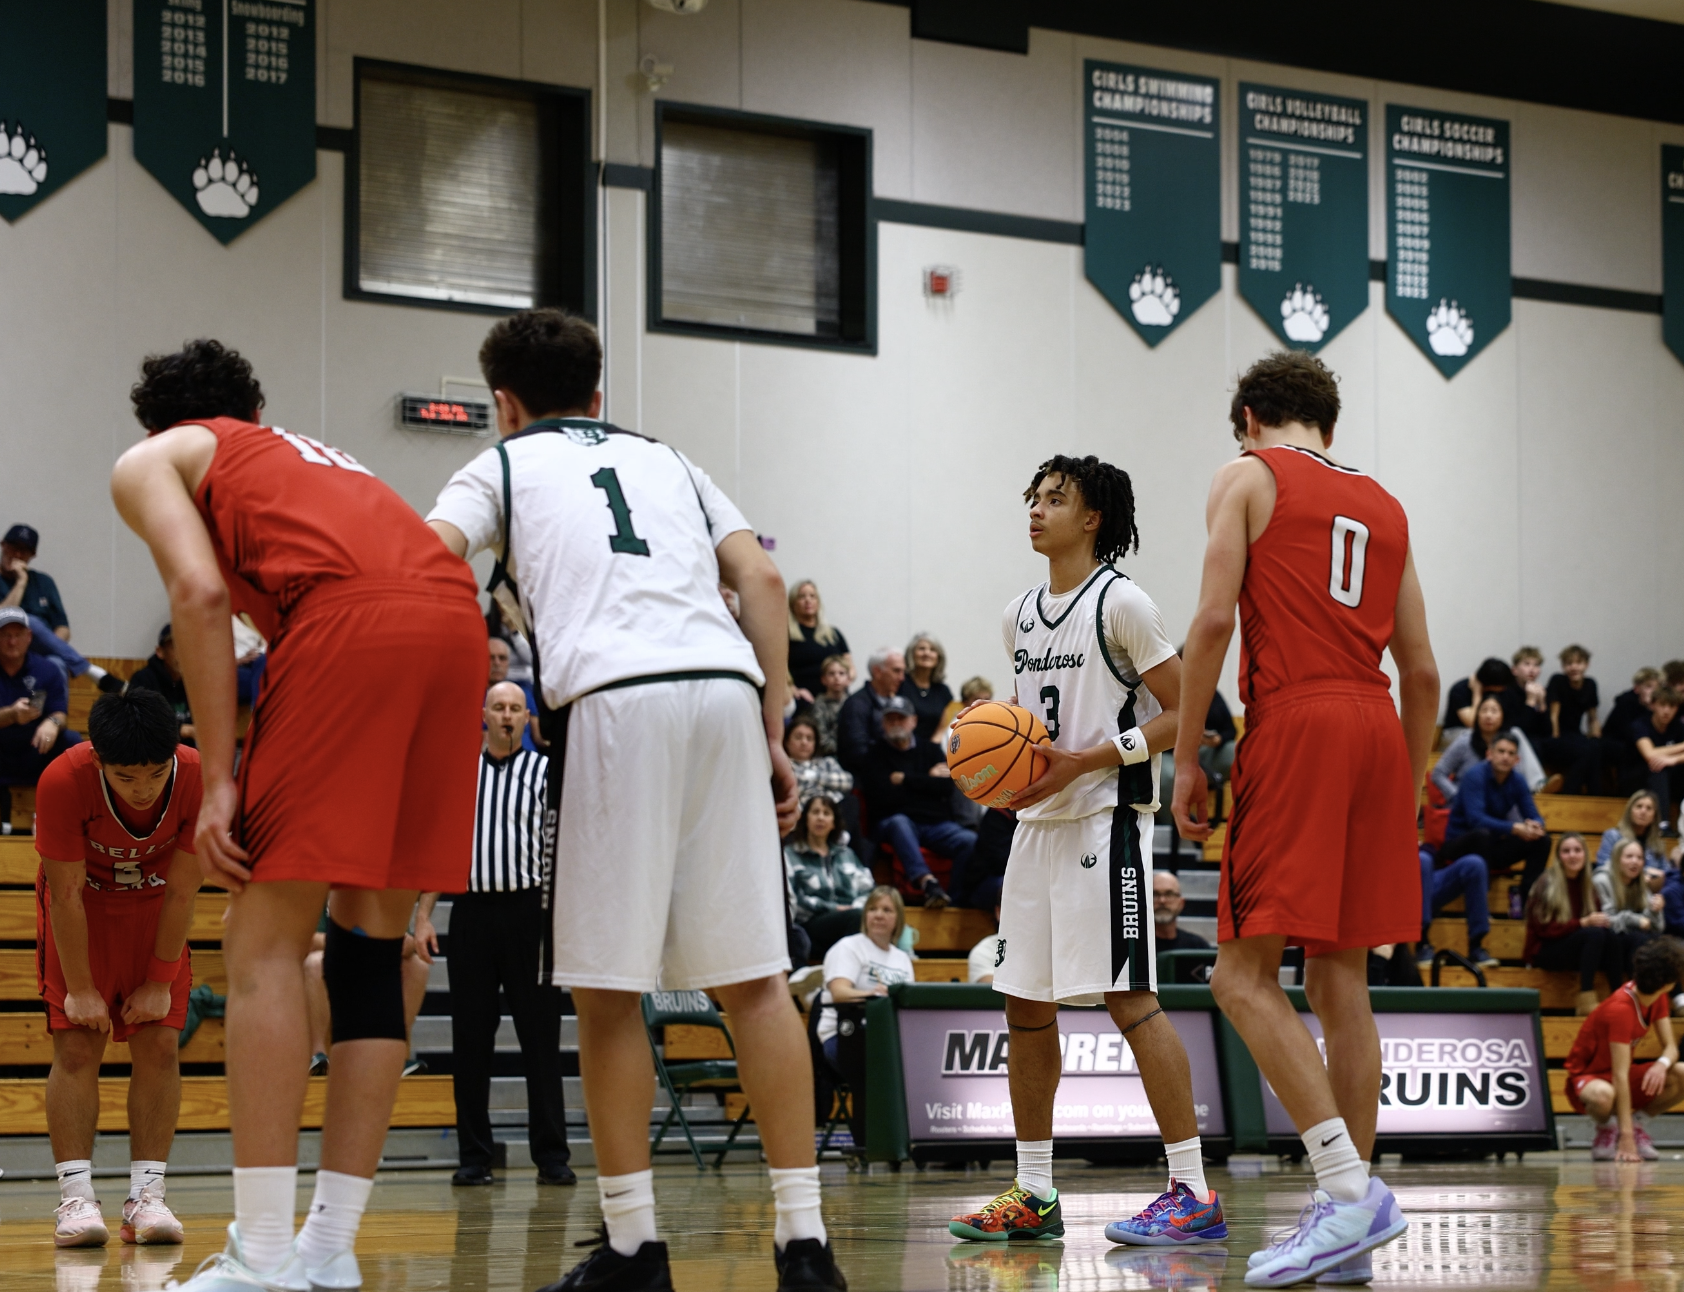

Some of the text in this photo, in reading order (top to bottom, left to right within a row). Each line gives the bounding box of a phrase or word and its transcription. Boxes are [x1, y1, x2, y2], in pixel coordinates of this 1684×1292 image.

[161, 9, 206, 28] 2012
[230, 0, 305, 27] Snowboarding
[161, 24, 206, 44] 2013
[245, 21, 290, 40] 2012
[160, 39, 207, 58] 2014
[245, 36, 289, 56] 2015
[161, 54, 206, 73] 2015
[245, 51, 289, 71] 2016
[161, 68, 206, 88] 2016
[244, 65, 288, 85] 2017
[1092, 69, 1214, 104] GIRLS SWIMMING
[1093, 90, 1212, 124] CHAMPIONSHIPS
[1246, 91, 1362, 125] GIRLS VOLLEYBALL
[1254, 112, 1355, 144] CHAMPIONSHIPS
[1400, 114, 1495, 144] GIRLS SOCCER
[1392, 133, 1504, 164] CHAMPIONSHIPS
[590, 467, 651, 557] 1
[1328, 515, 1370, 608] 0
[1039, 685, 1061, 742] 3
[89, 836, 175, 859] BELL
[1121, 866, 1139, 940] BRUINS
[651, 990, 710, 1013] BRUINS
[925, 1102, 963, 1120] Visit
[1092, 1104, 1114, 1118] on
